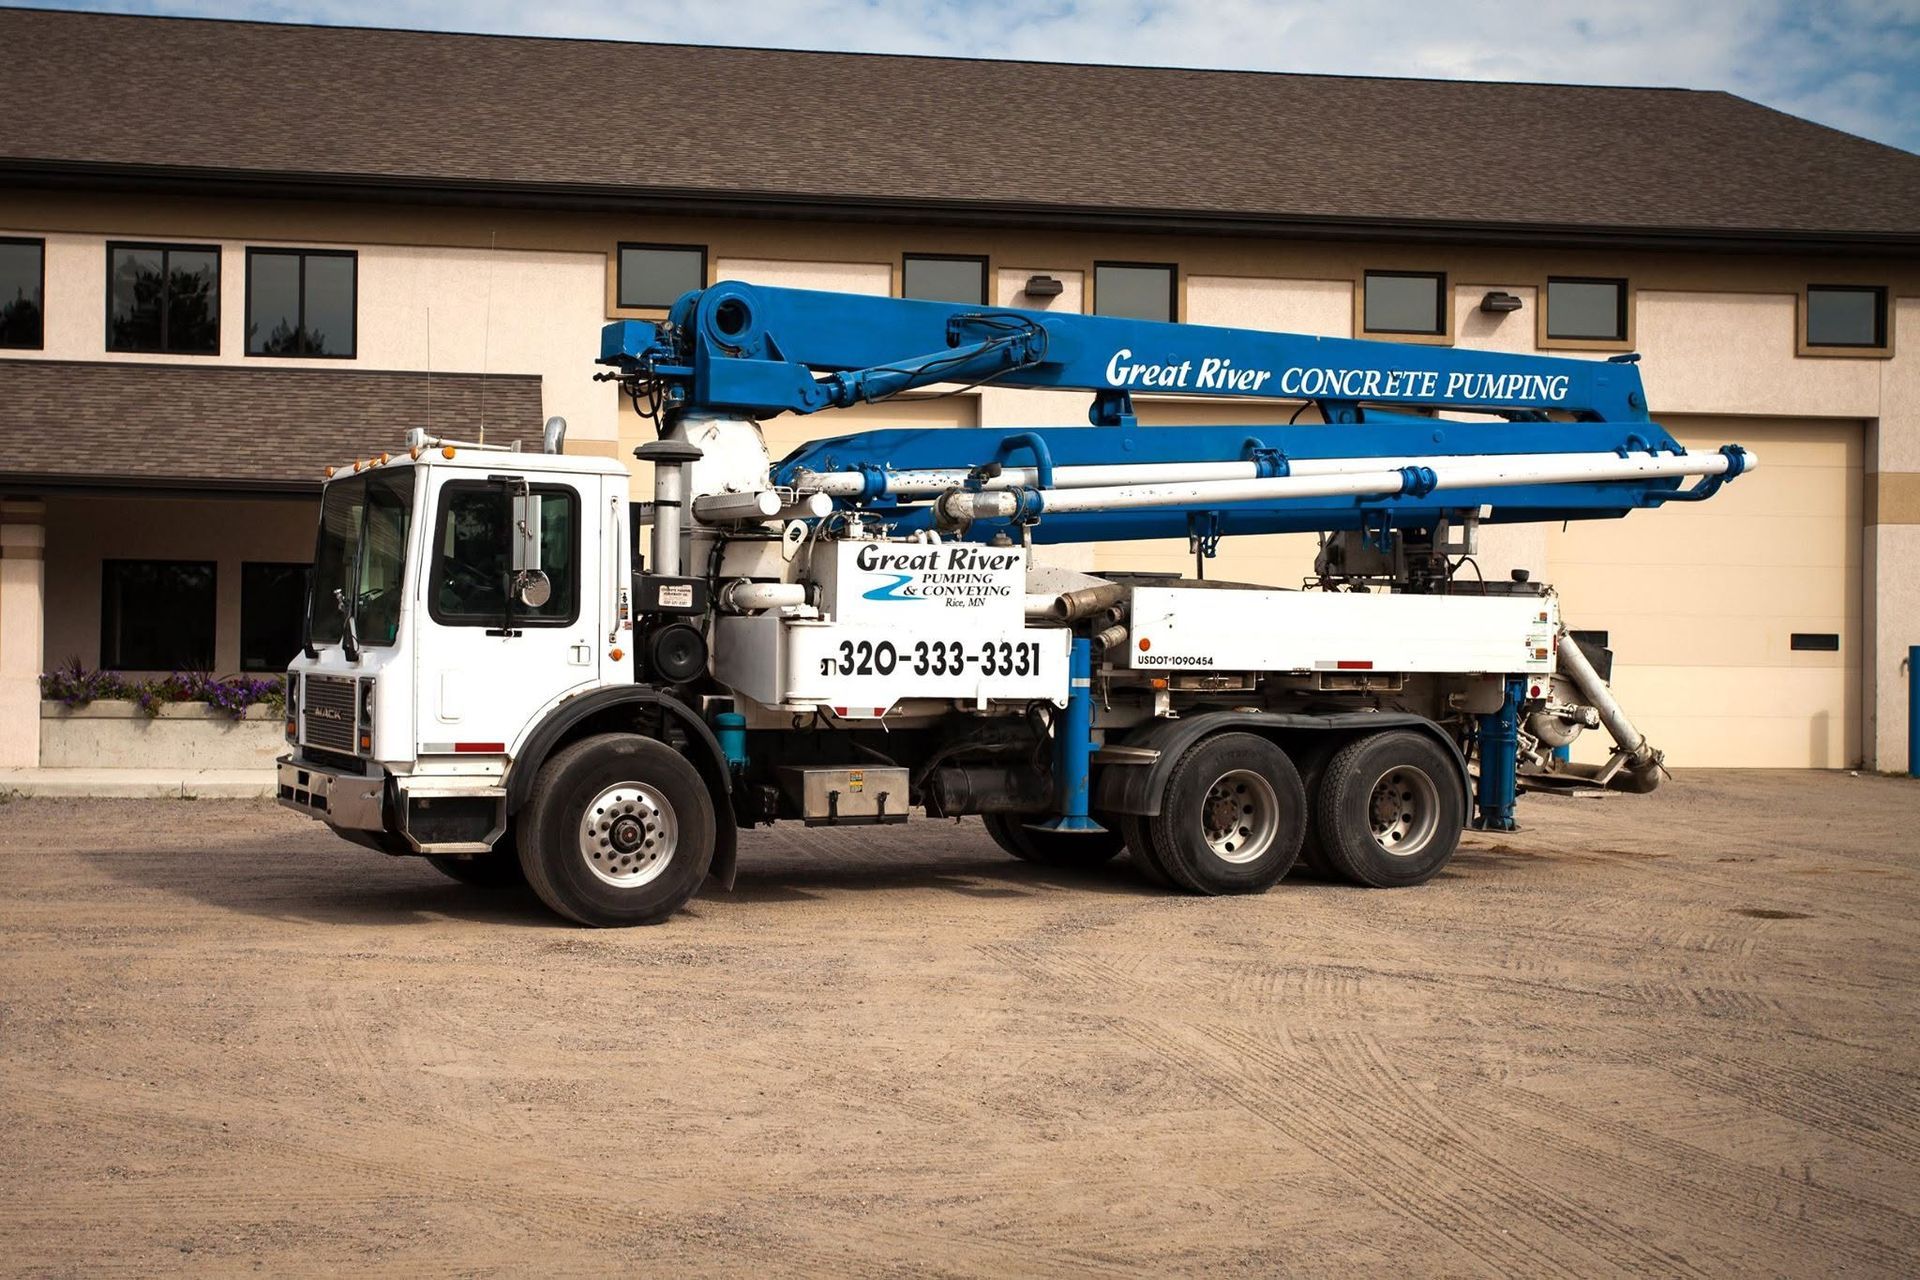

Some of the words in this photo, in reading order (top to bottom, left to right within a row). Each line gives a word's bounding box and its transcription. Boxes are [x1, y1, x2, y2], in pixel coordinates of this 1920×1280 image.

[1105, 348, 1192, 387] Great
[1195, 357, 1271, 391] River
[1280, 367, 1438, 397] CONCRETE
[1444, 372, 1569, 401] PUMPING
[856, 543, 940, 572] Great
[947, 548, 1020, 571] River
[922, 573, 994, 584] PUMPING
[903, 585, 918, 596] &
[922, 585, 1011, 597] CONVEYING
[945, 597, 966, 608] Rice,
[967, 597, 986, 607] MN
[838, 639, 1040, 677] 320-333-3331
[314, 706, 342, 720] MACK
